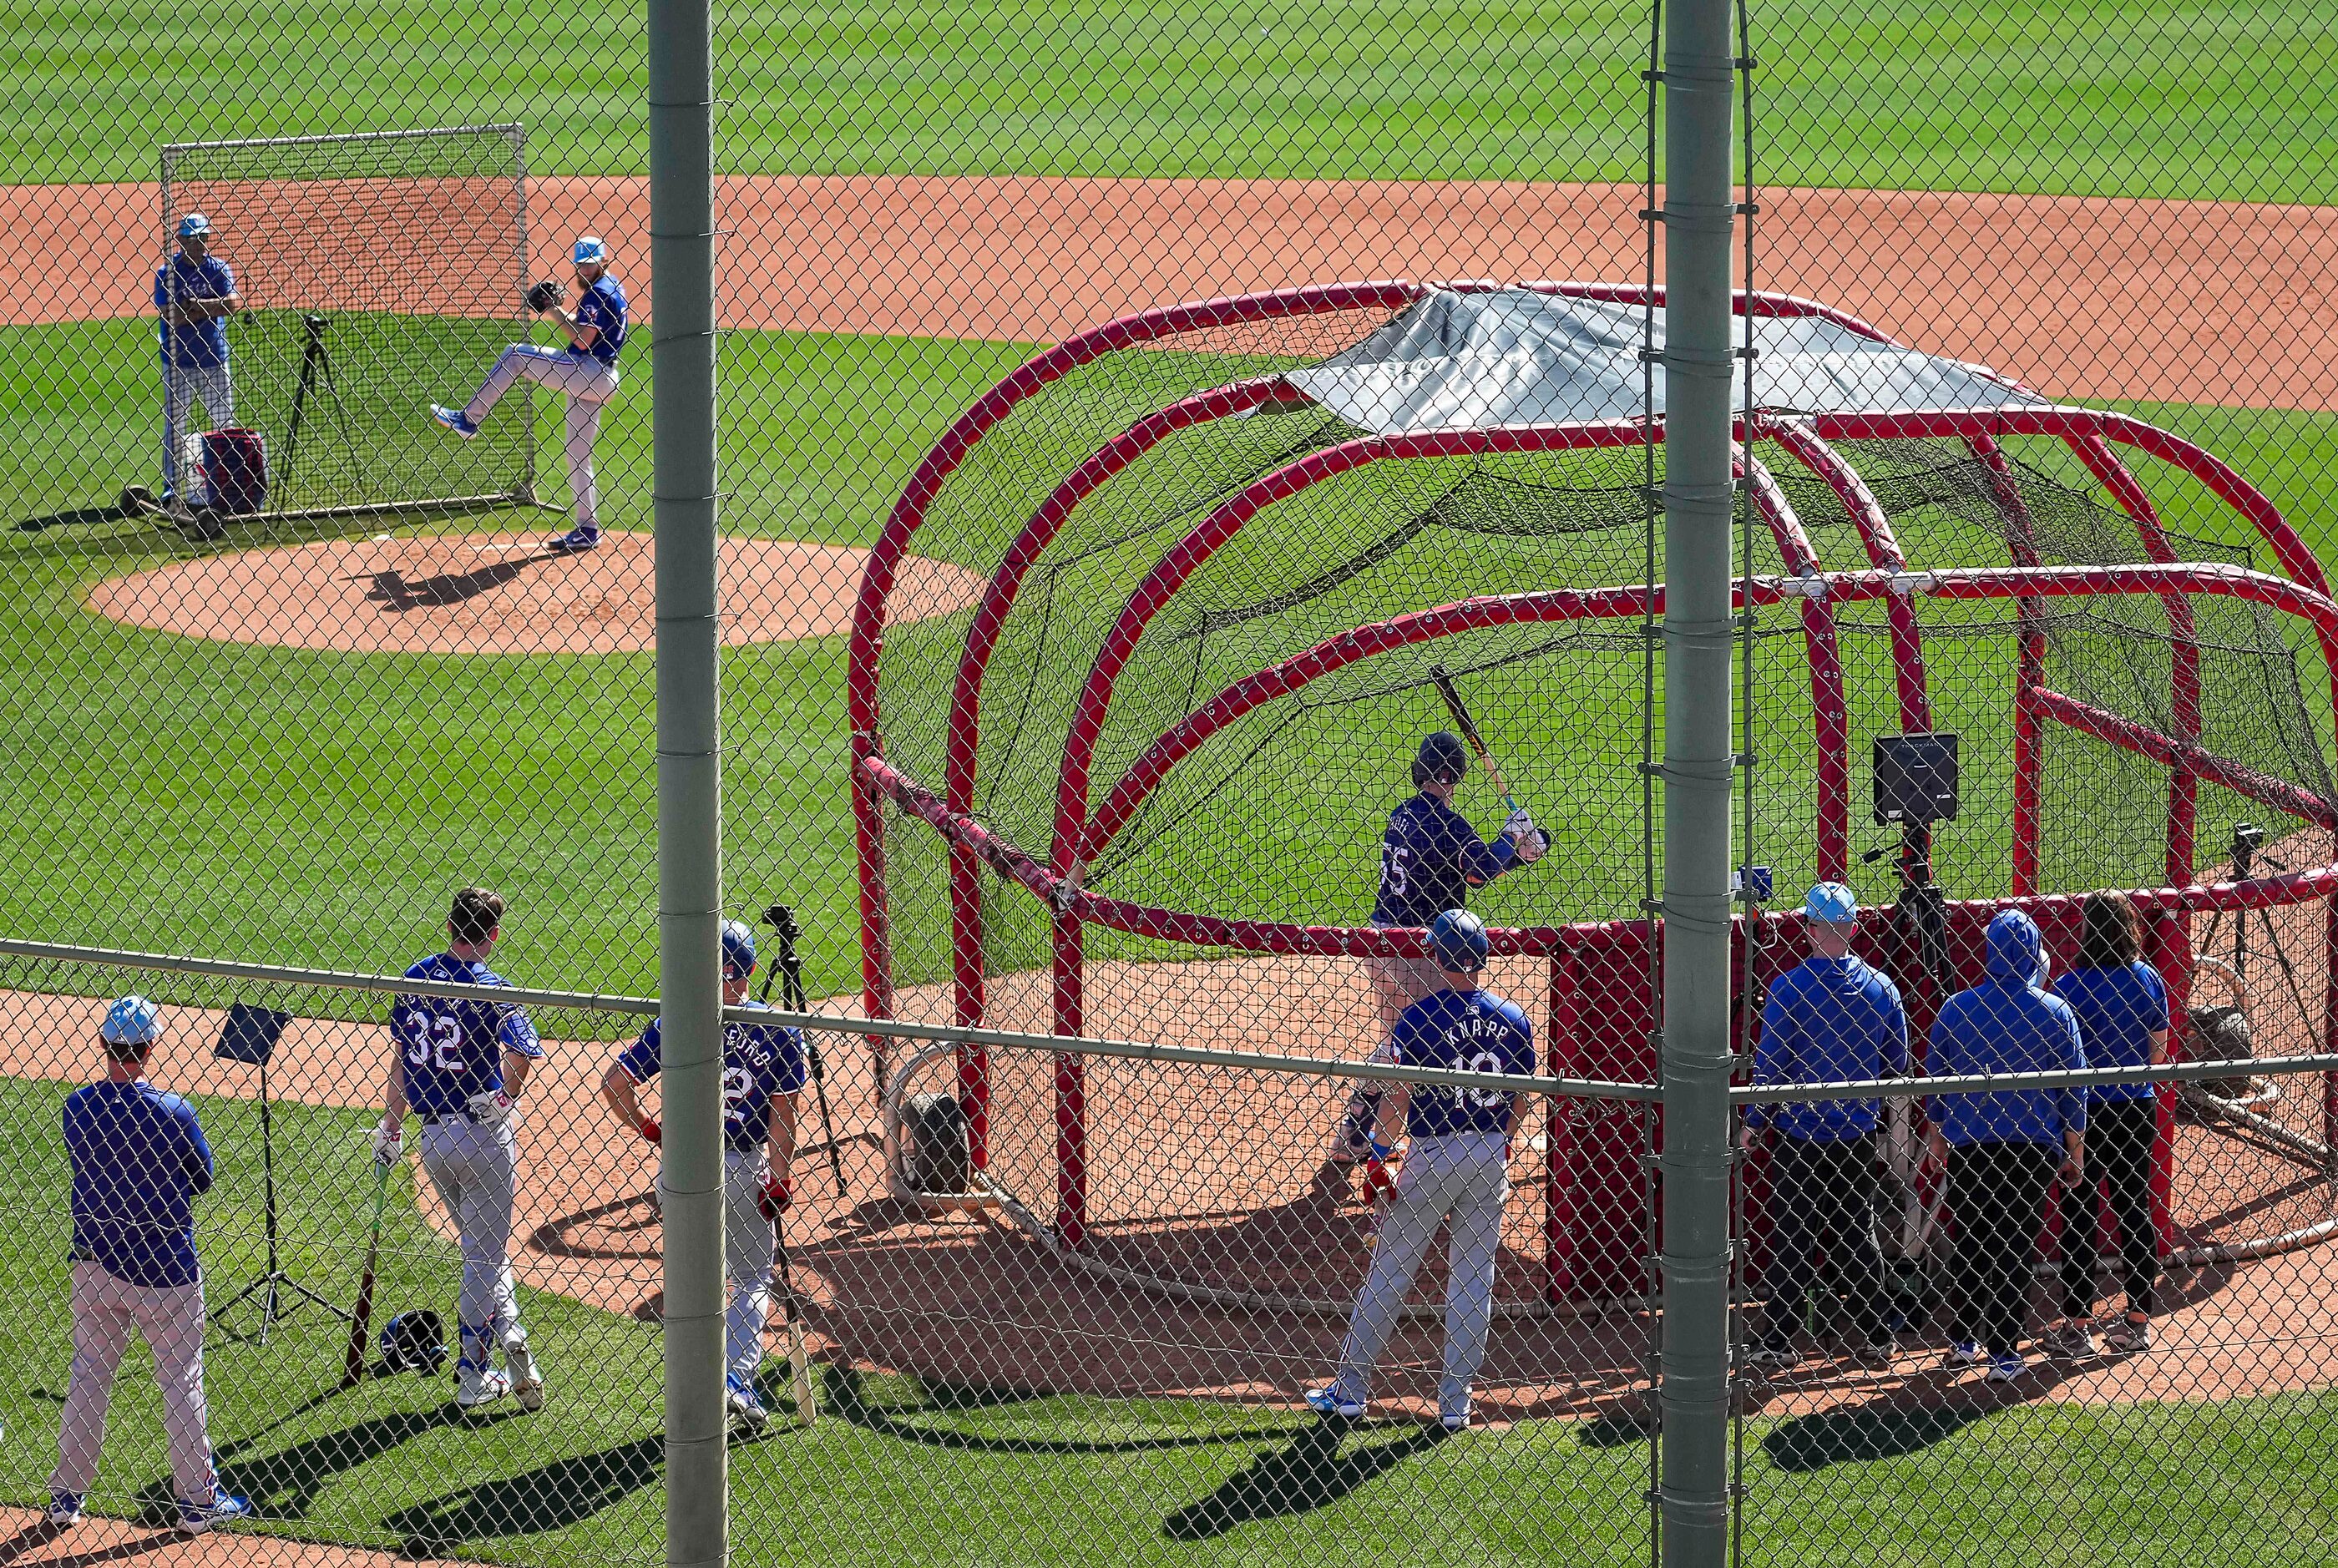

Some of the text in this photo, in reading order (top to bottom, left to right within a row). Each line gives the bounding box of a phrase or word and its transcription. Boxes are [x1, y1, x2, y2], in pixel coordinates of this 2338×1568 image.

[406, 1011, 463, 1070] 32
[726, 1029, 771, 1066] FORD
[1445, 1019, 1508, 1044] KNAPP
[723, 1067, 753, 1122] 2
[1451, 1052, 1501, 1108] 10
